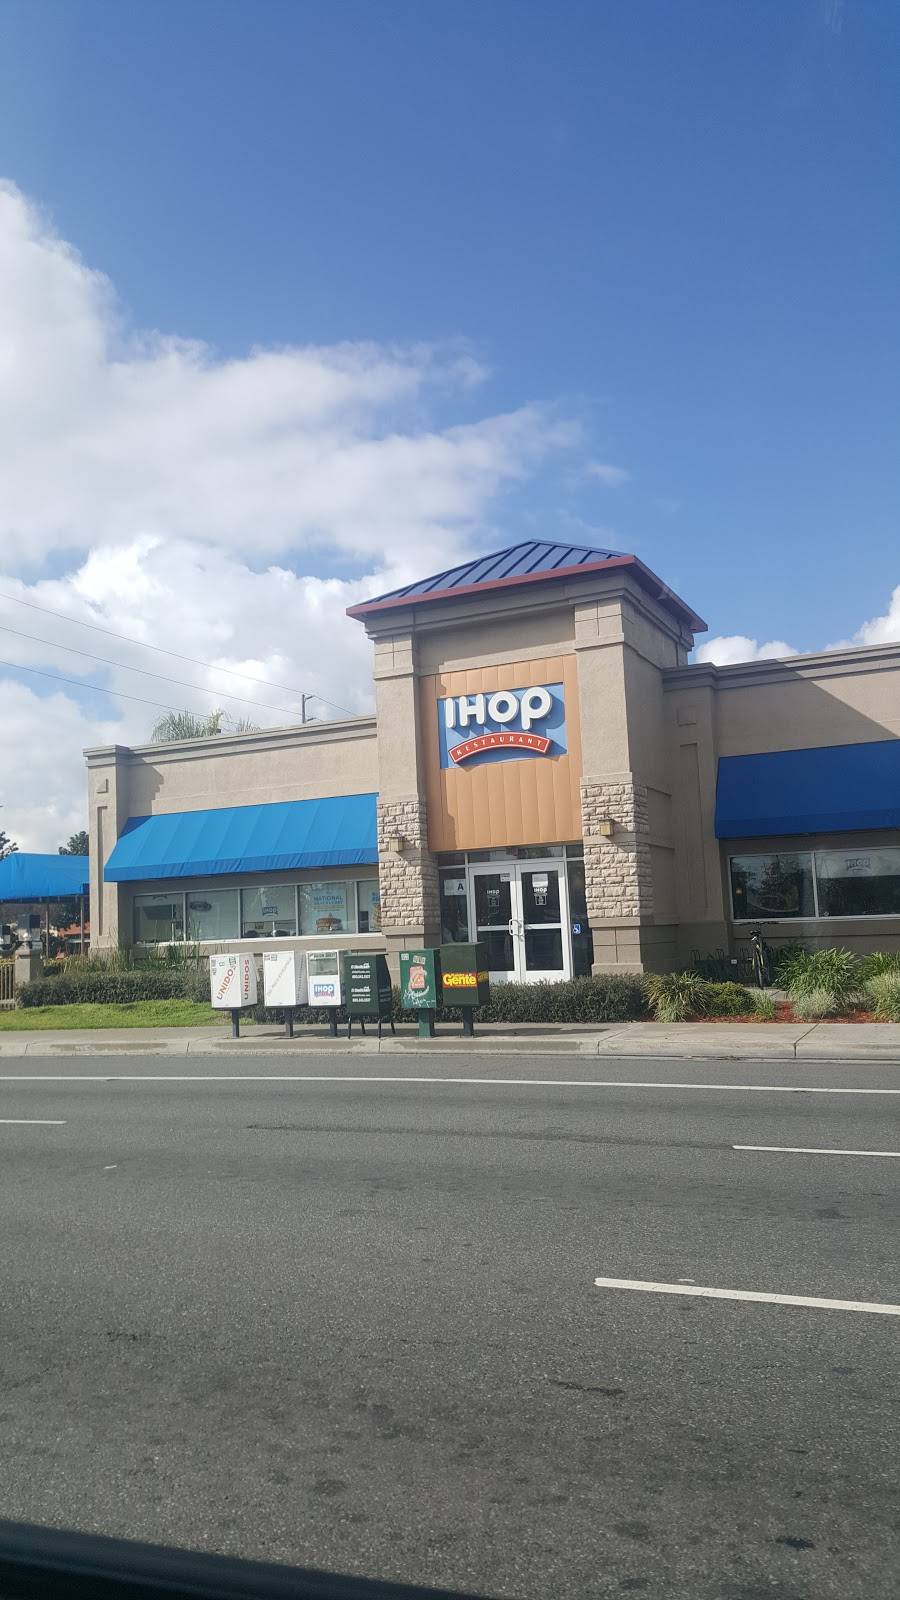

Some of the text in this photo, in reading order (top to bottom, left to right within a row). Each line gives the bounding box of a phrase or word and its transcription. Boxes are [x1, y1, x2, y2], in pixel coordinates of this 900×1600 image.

[445, 686, 552, 730] IHOP
[456, 735, 543, 756] RESTAURANT
[442, 973, 477, 986] Gente
